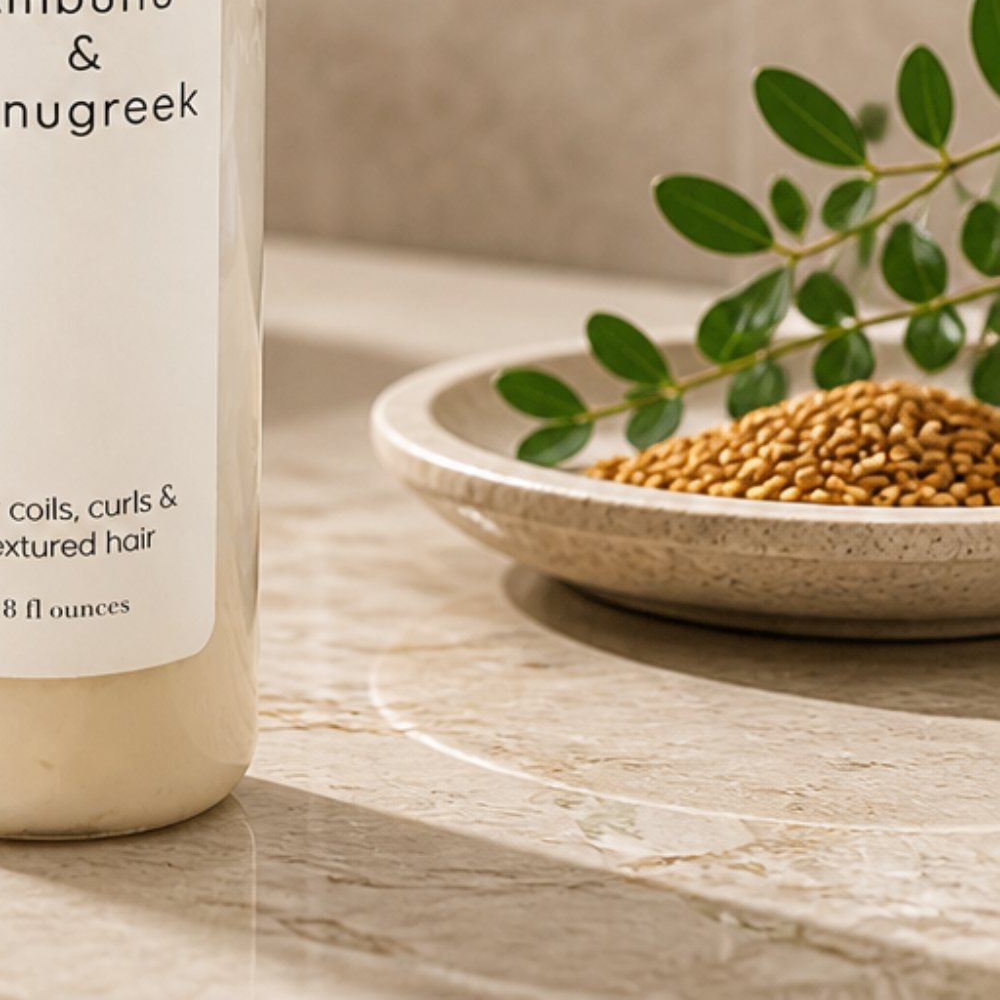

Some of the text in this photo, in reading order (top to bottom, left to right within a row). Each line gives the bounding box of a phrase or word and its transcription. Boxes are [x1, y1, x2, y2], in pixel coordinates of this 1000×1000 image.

[67, 34, 102, 72] &
[8, 496, 80, 524] coils,
[87, 489, 153, 519] curls
[159, 483, 179, 509] &
[106, 526, 156, 555] hair
[2, 598, 131, 620] 8 fl ounces
